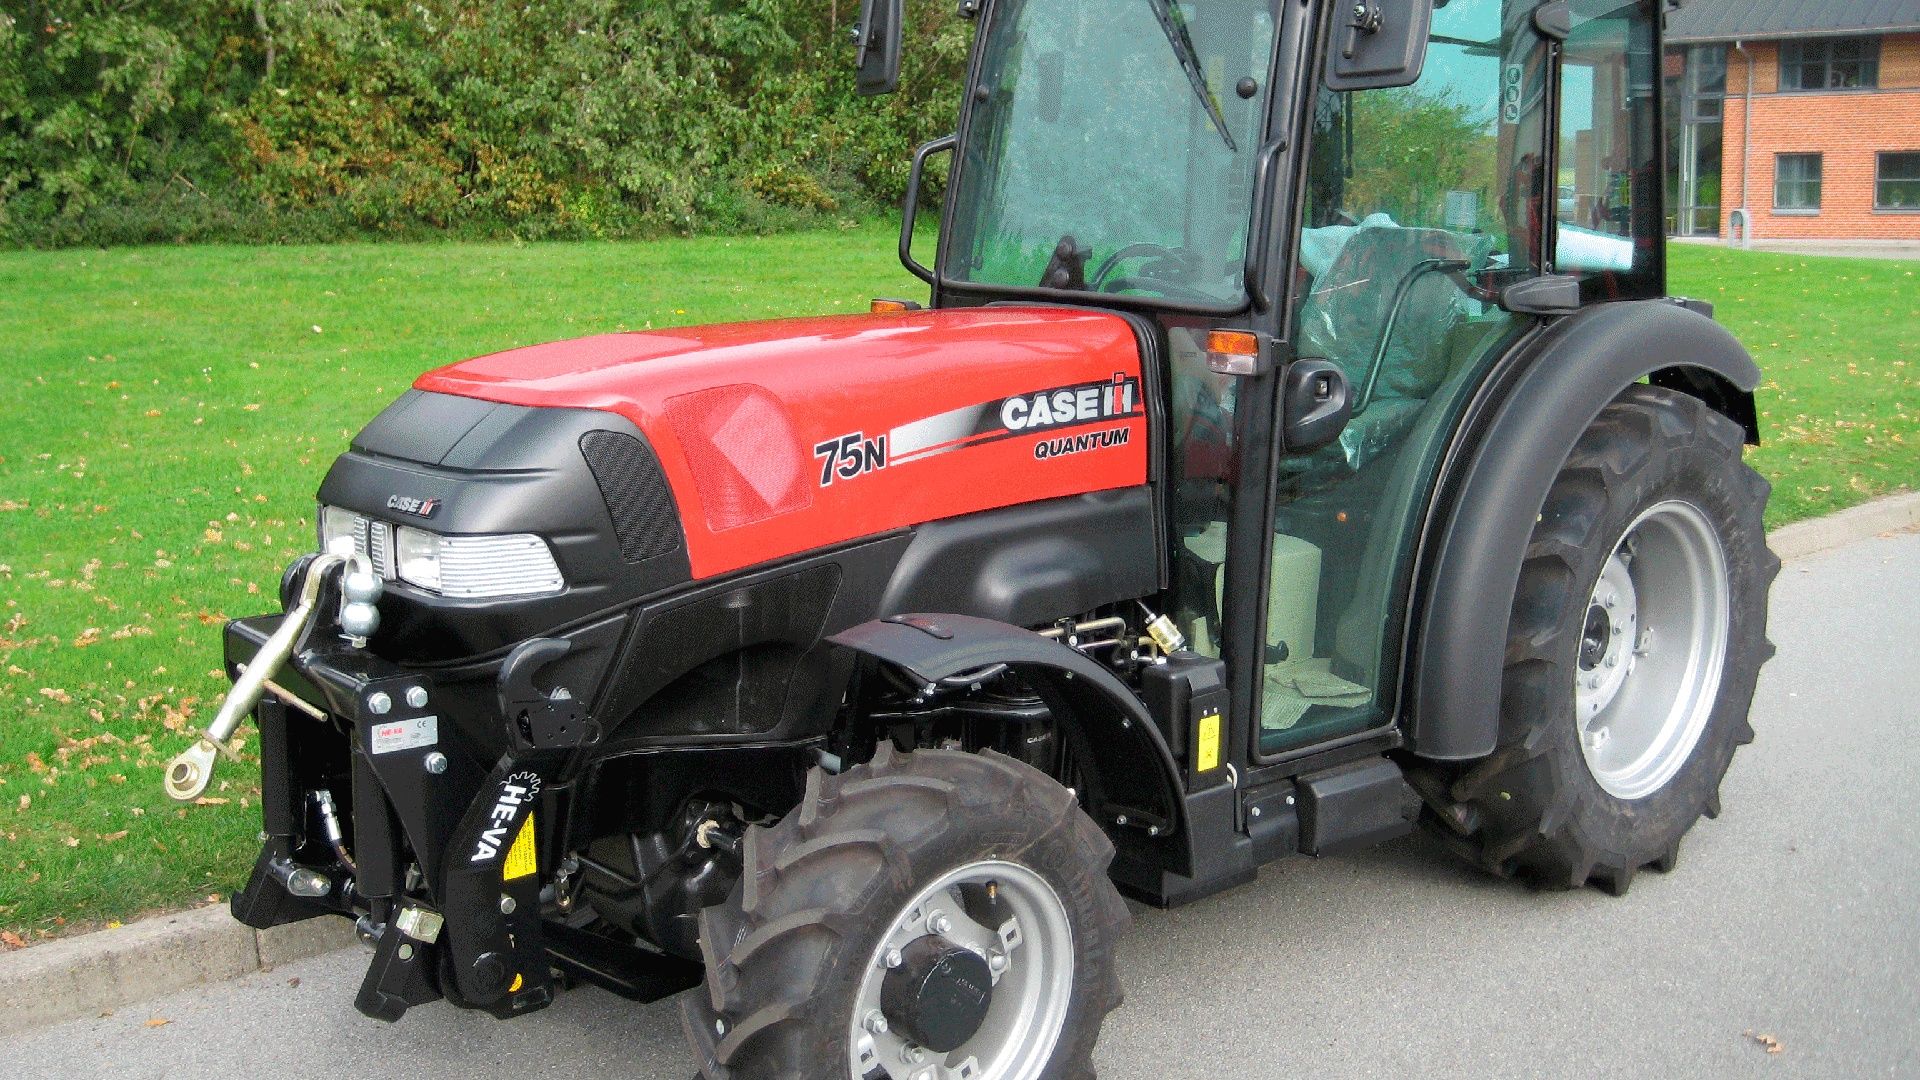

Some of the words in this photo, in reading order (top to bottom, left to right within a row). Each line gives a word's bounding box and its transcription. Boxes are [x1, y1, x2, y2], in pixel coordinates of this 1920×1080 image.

[1001, 387, 1099, 430] CASE
[814, 431, 886, 487] 75N
[1034, 427, 1130, 459] QUANTUM
[386, 495, 421, 513] CASE
[470, 784, 527, 862] HE-VA
